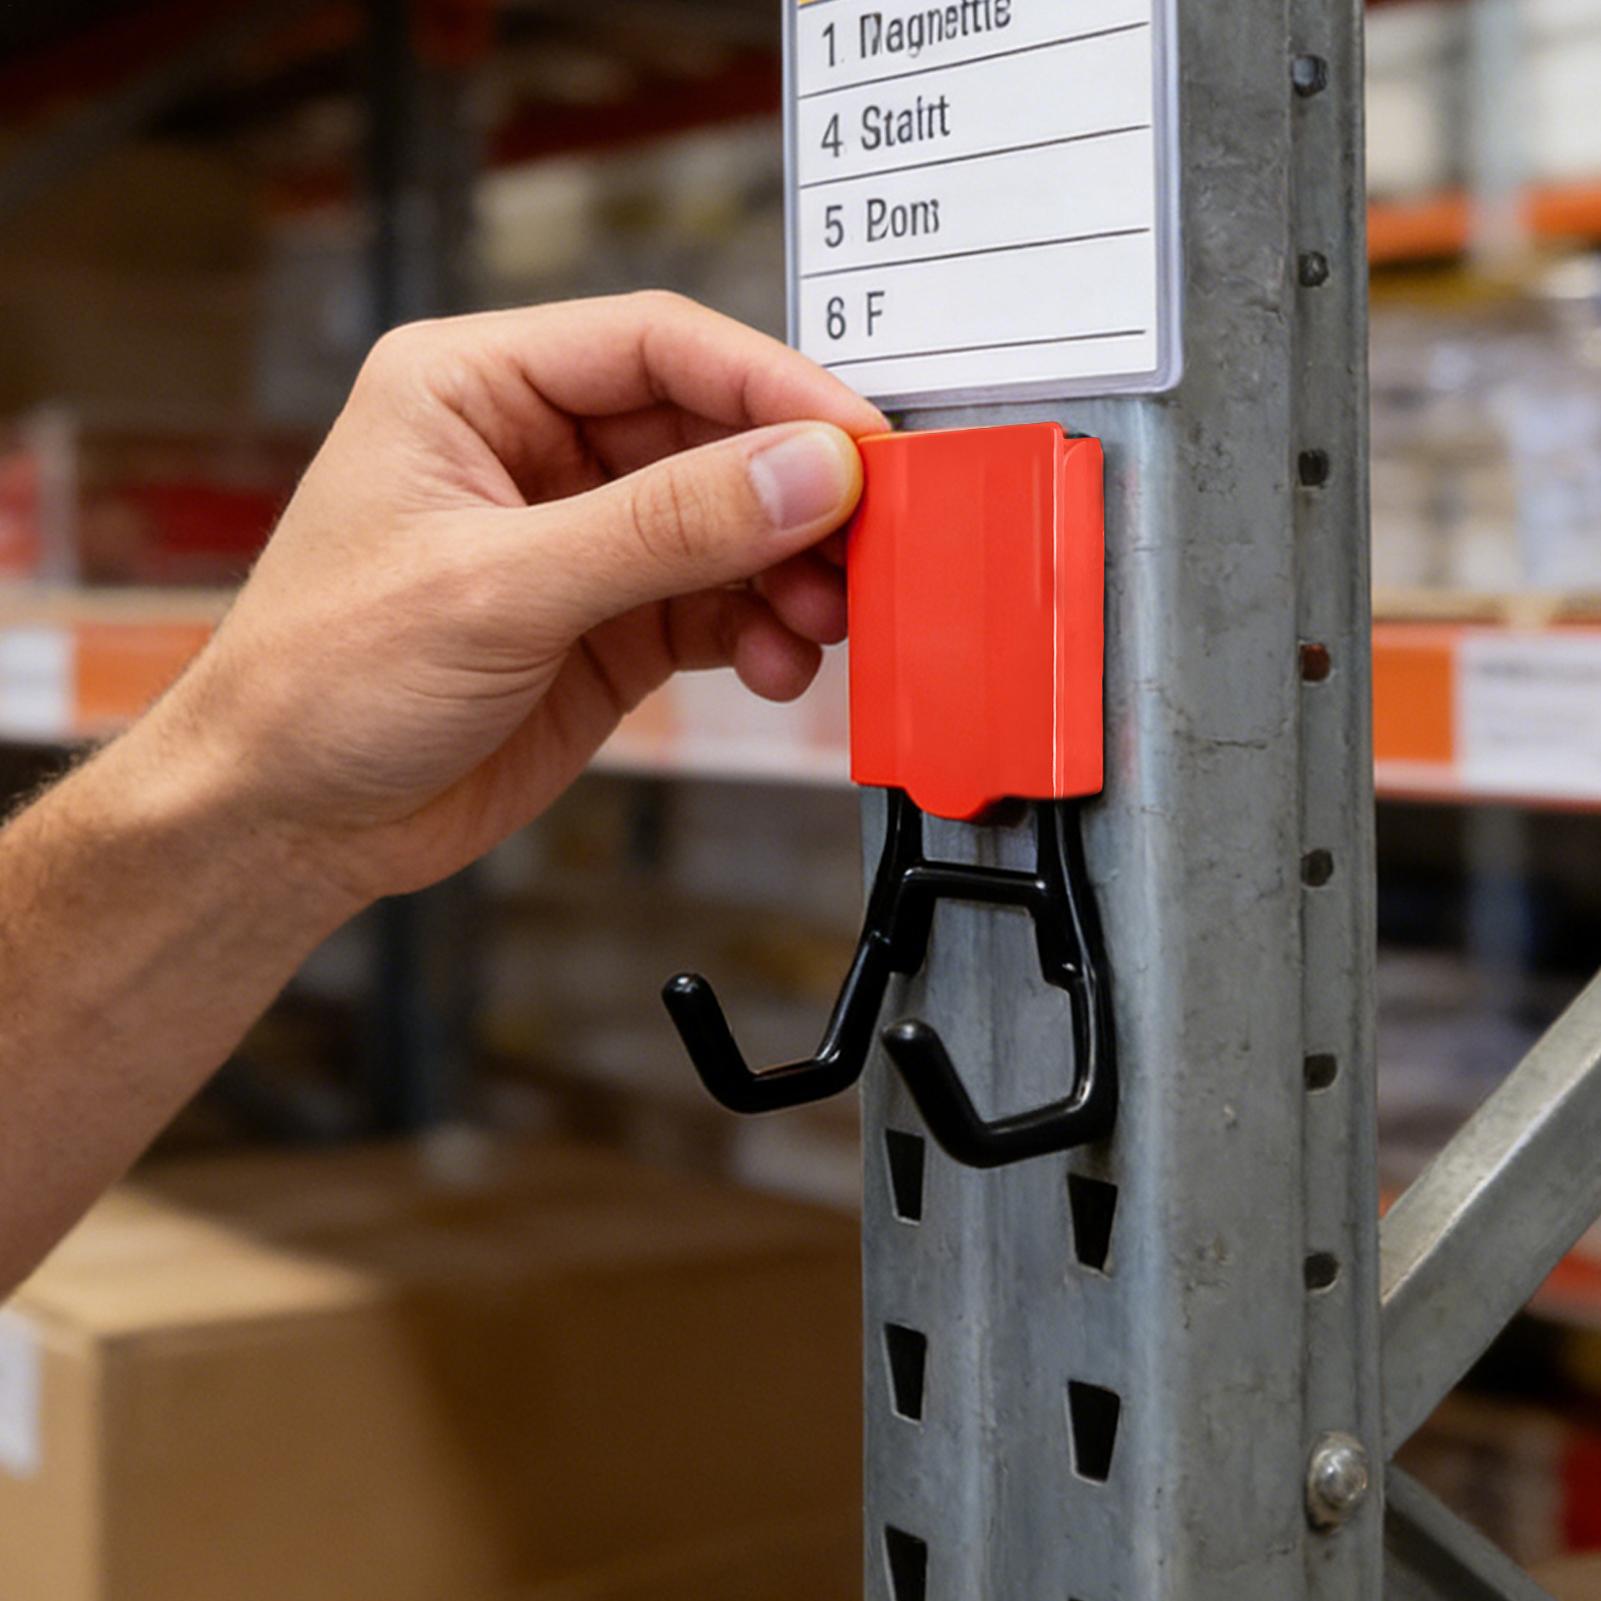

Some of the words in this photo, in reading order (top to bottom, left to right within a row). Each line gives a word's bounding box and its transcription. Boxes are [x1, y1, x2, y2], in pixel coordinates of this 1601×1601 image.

[821, 21, 836, 68] 1
[820, 113, 844, 158] 4
[824, 204, 845, 248] 5
[866, 290, 885, 337] F
